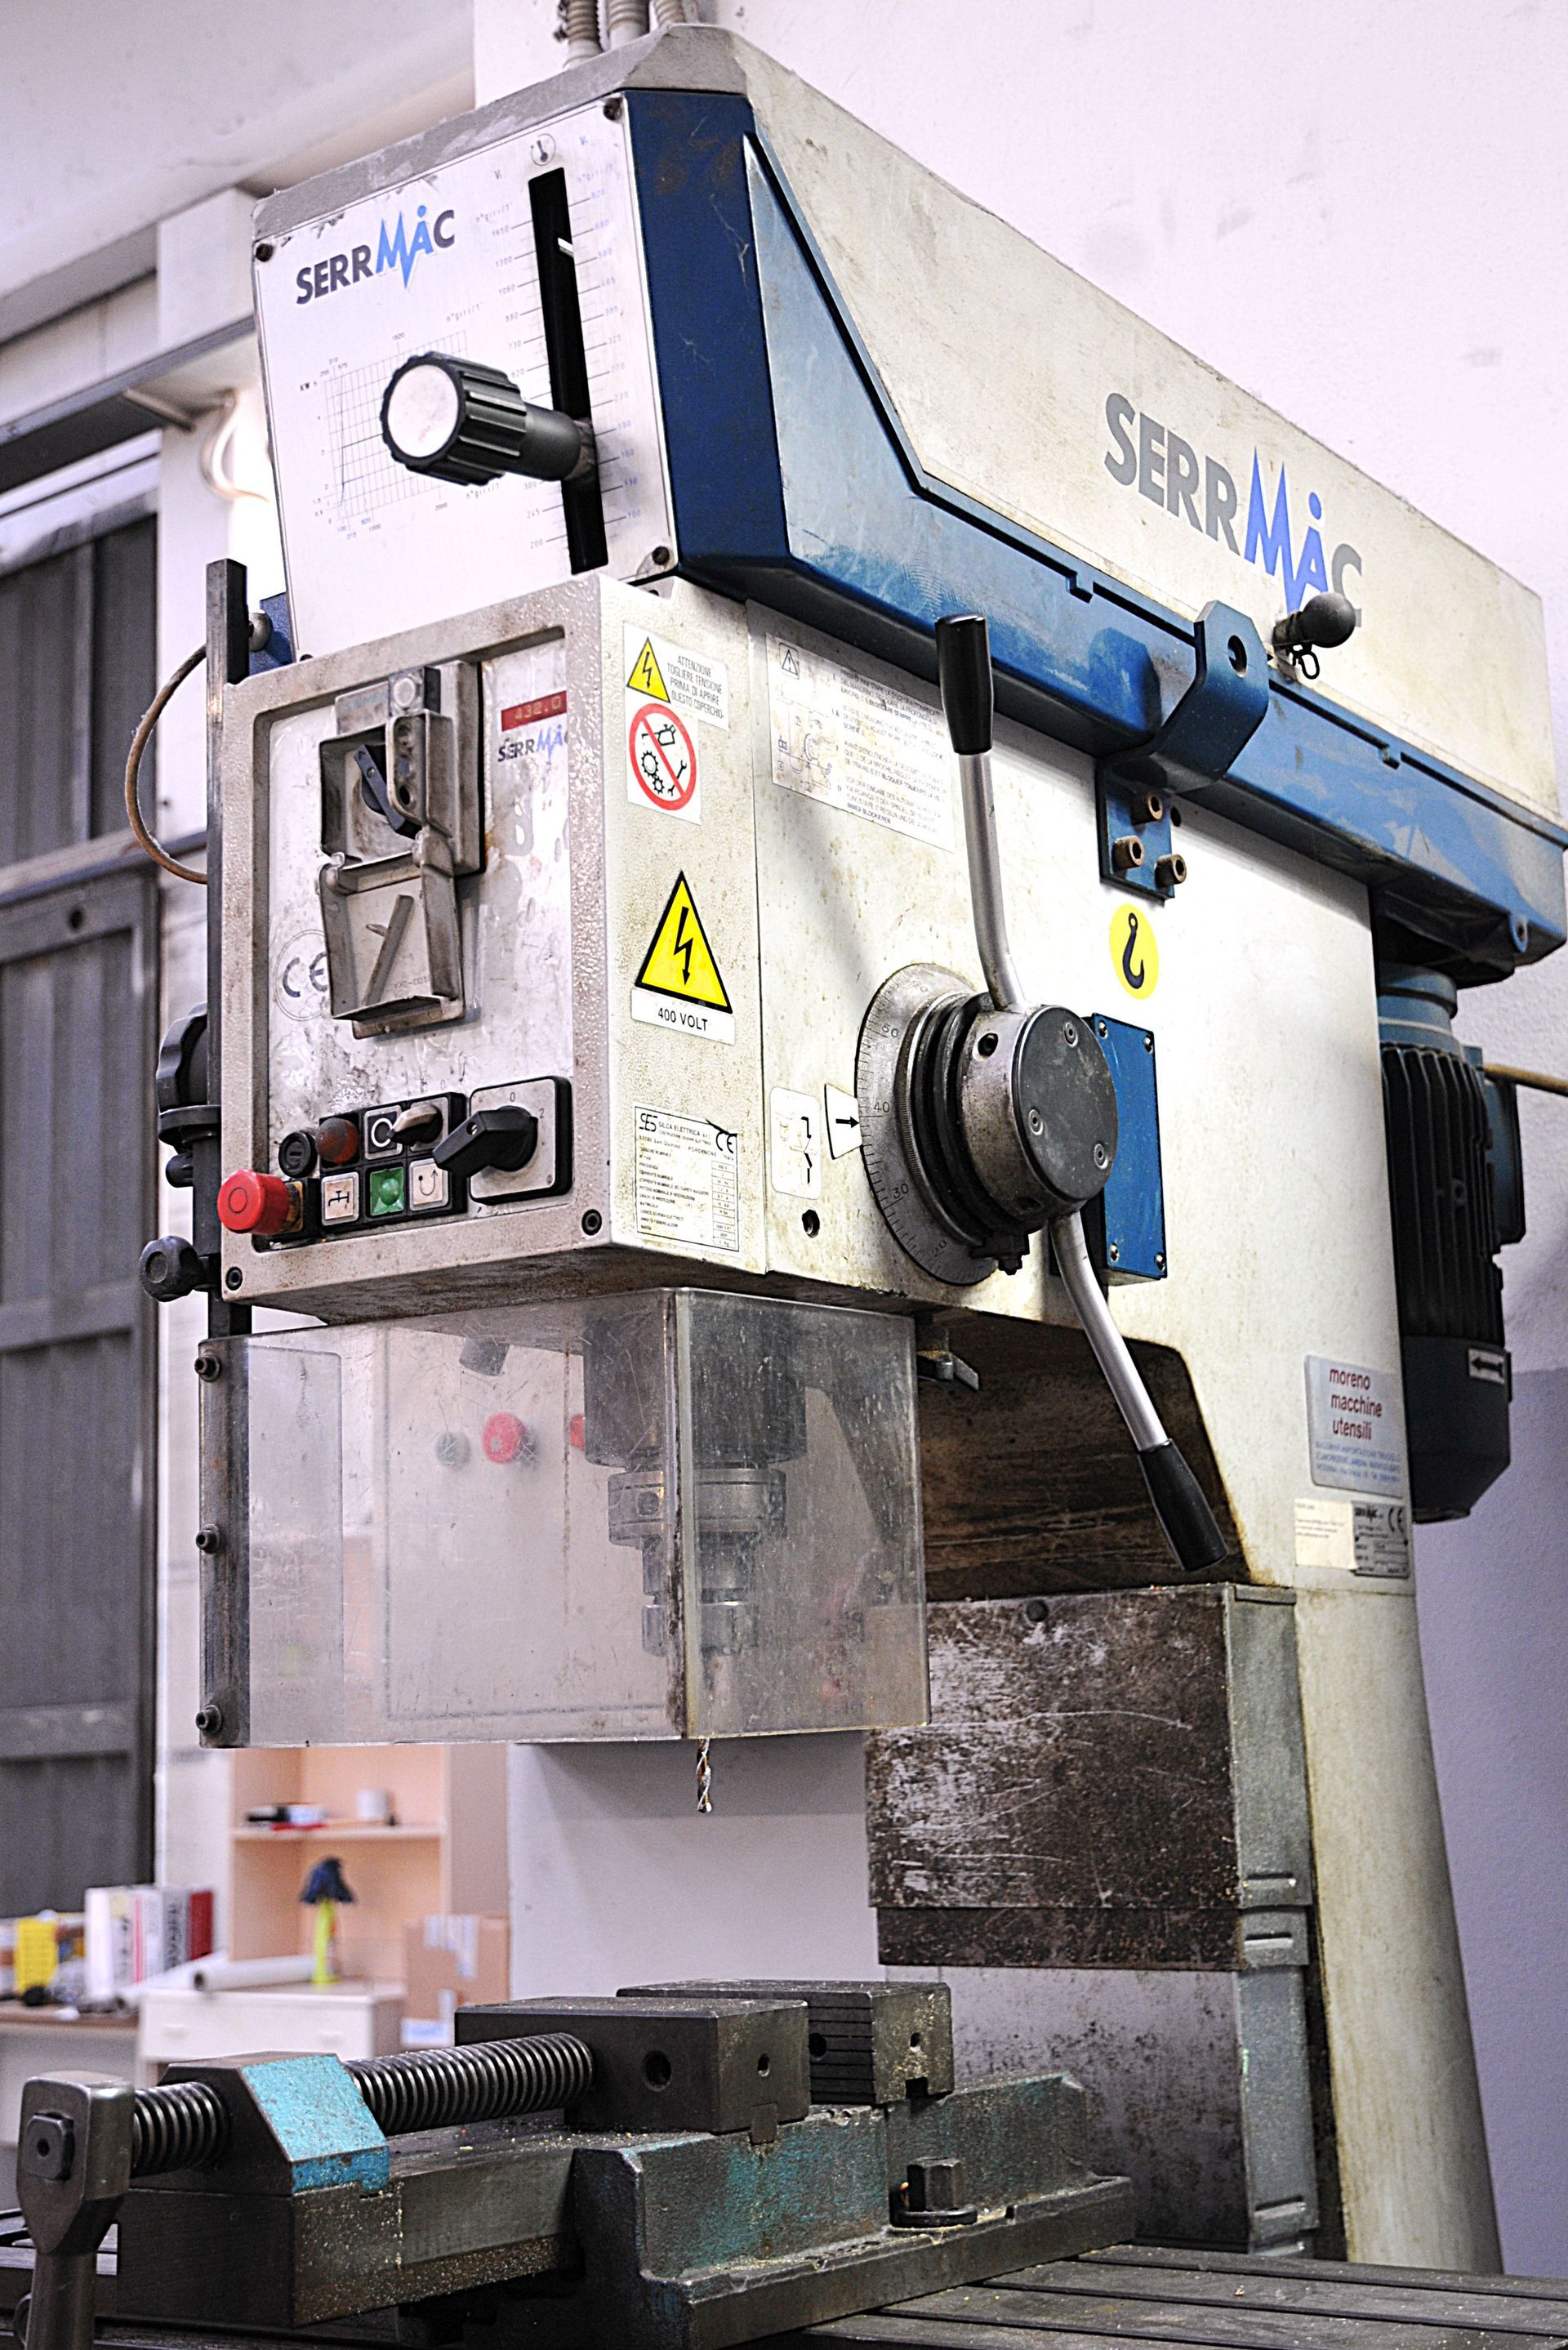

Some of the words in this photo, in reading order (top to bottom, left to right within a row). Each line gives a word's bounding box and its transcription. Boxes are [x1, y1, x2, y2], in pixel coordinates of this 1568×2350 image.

[296, 205, 455, 305] SERRMAC
[627, 509, 641, 519] 100
[678, 655, 711, 677] ATTENZIONE
[667, 662, 693, 683] TOGLIERE
[696, 675, 722, 694] TENSIONE
[670, 676, 690, 692] PRIMA
[692, 686, 697, 696] DI
[699, 689, 719, 706] APRIRE
[671, 689, 693, 707] QUESTO
[283, 952, 327, 997] CE
[658, 1008, 676, 1023] 400
[680, 1013, 708, 1031] VOLT
[510, 1091, 515, 1103] 0
[873, 1101, 890, 1113] 40
[539, 1108, 545, 1118] 2
[674, 1124, 700, 1137] ELETTRICA
[716, 1131, 737, 1153] CE
[893, 1183, 909, 1199] 30
[1329, 1368, 1370, 1390] moreno
[1331, 1394, 1383, 1418] macchine
[1333, 1417, 1372, 1441] utensili
